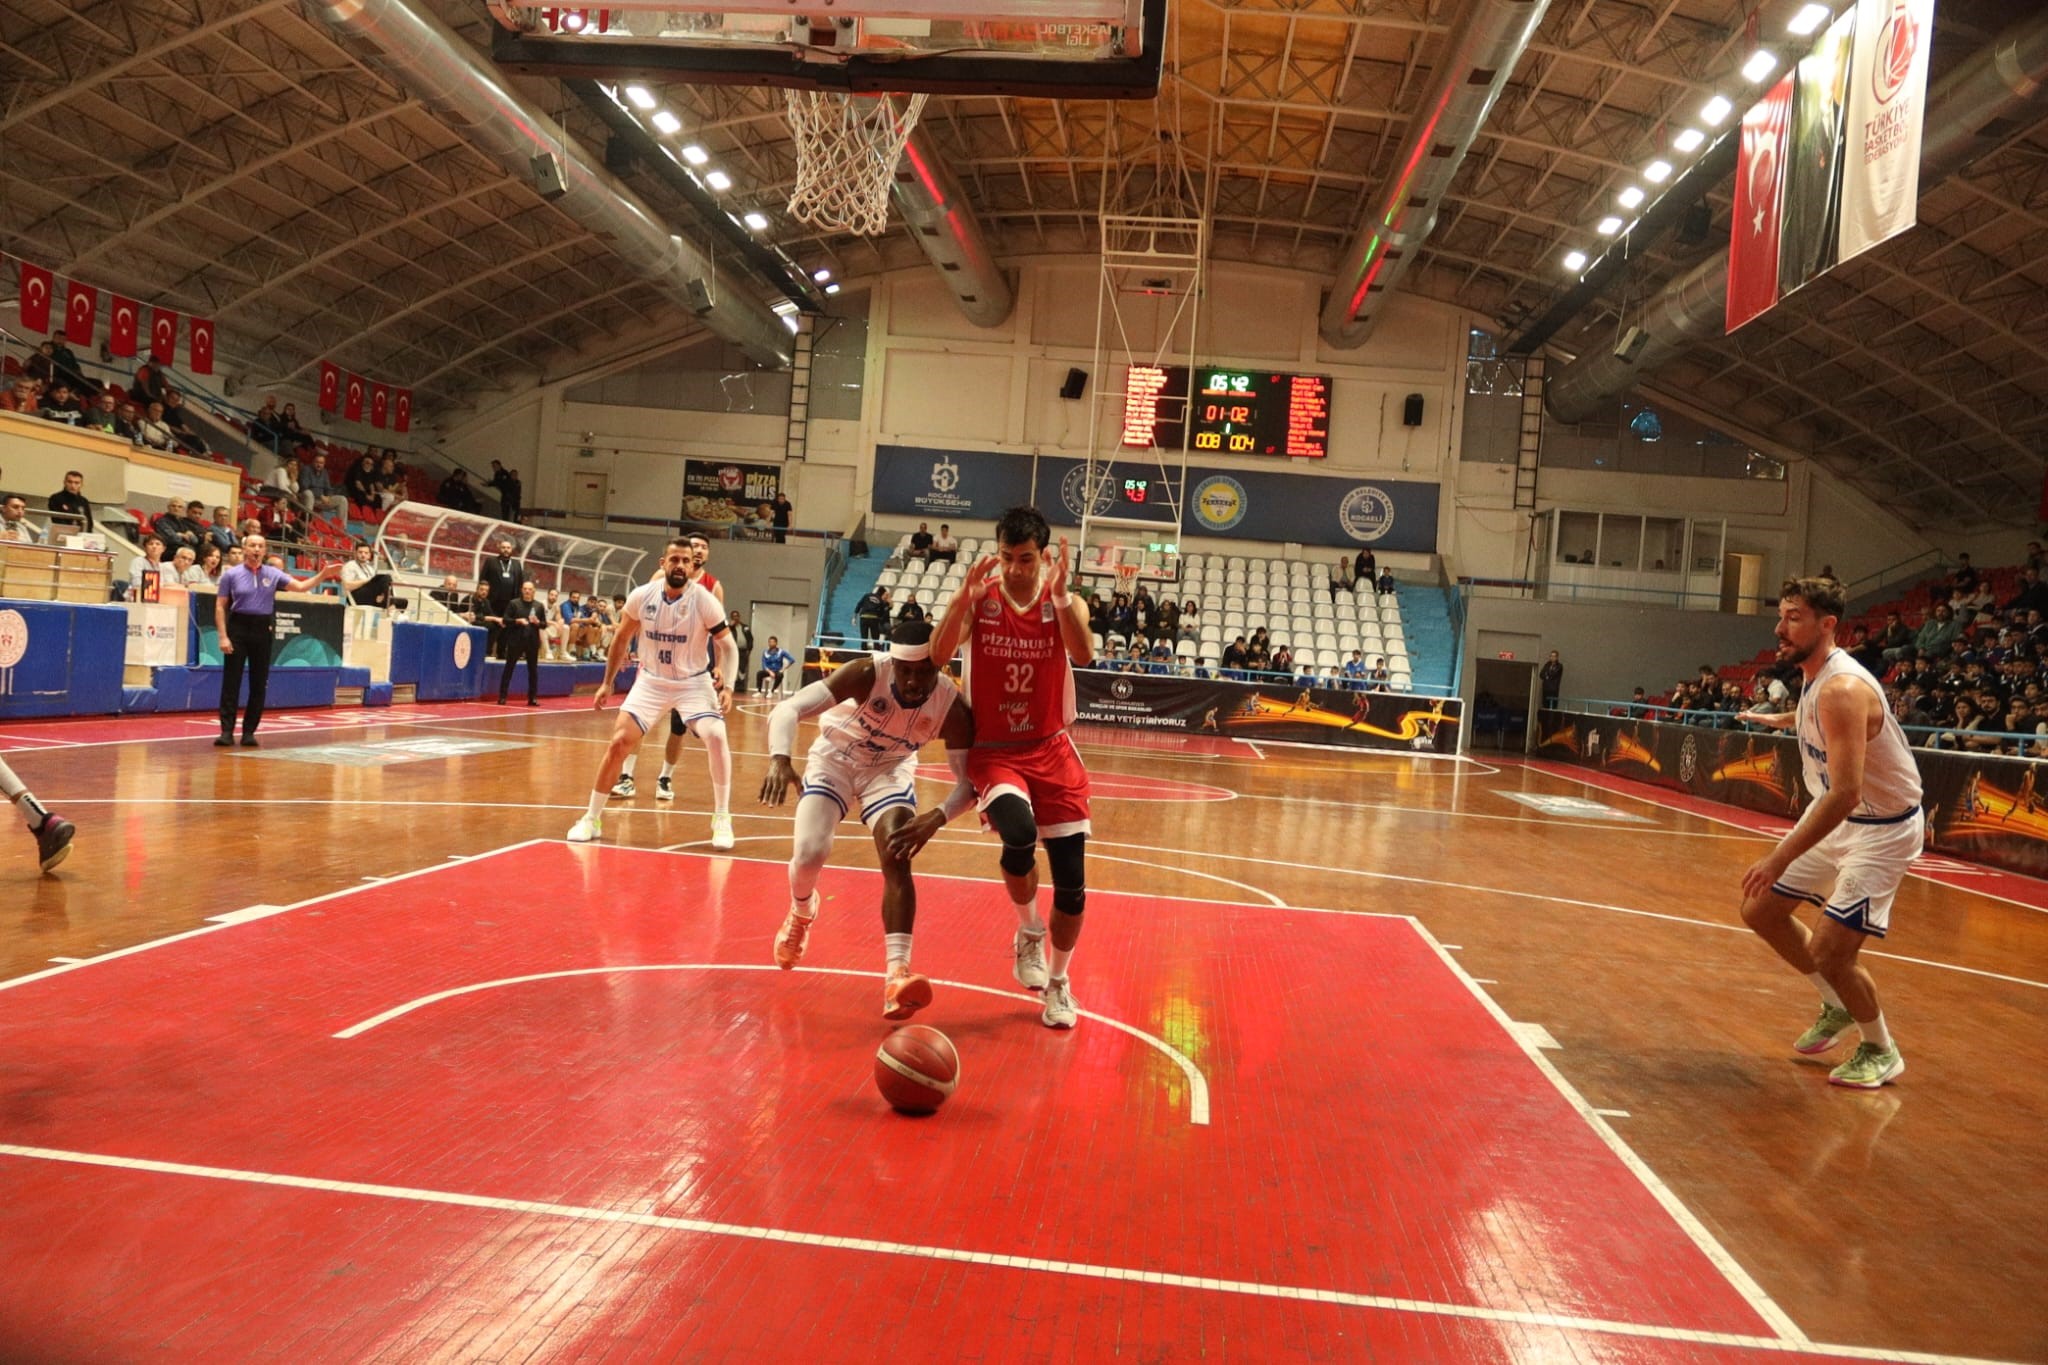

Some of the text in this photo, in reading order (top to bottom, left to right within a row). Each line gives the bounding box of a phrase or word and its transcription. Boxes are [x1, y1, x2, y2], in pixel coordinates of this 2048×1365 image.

[1864, 100, 1909, 139] TÜRKİYE
[1864, 120, 1908, 154] BASKETBO
[1195, 432, 1221, 449] 008
[1229, 434, 1256, 451] 004
[744, 484, 777, 500] BULLS
[1004, 663, 1034, 693] 32
[1075, 711, 1187, 727] ADAMLAR YETİŞTİRİYORUZ
